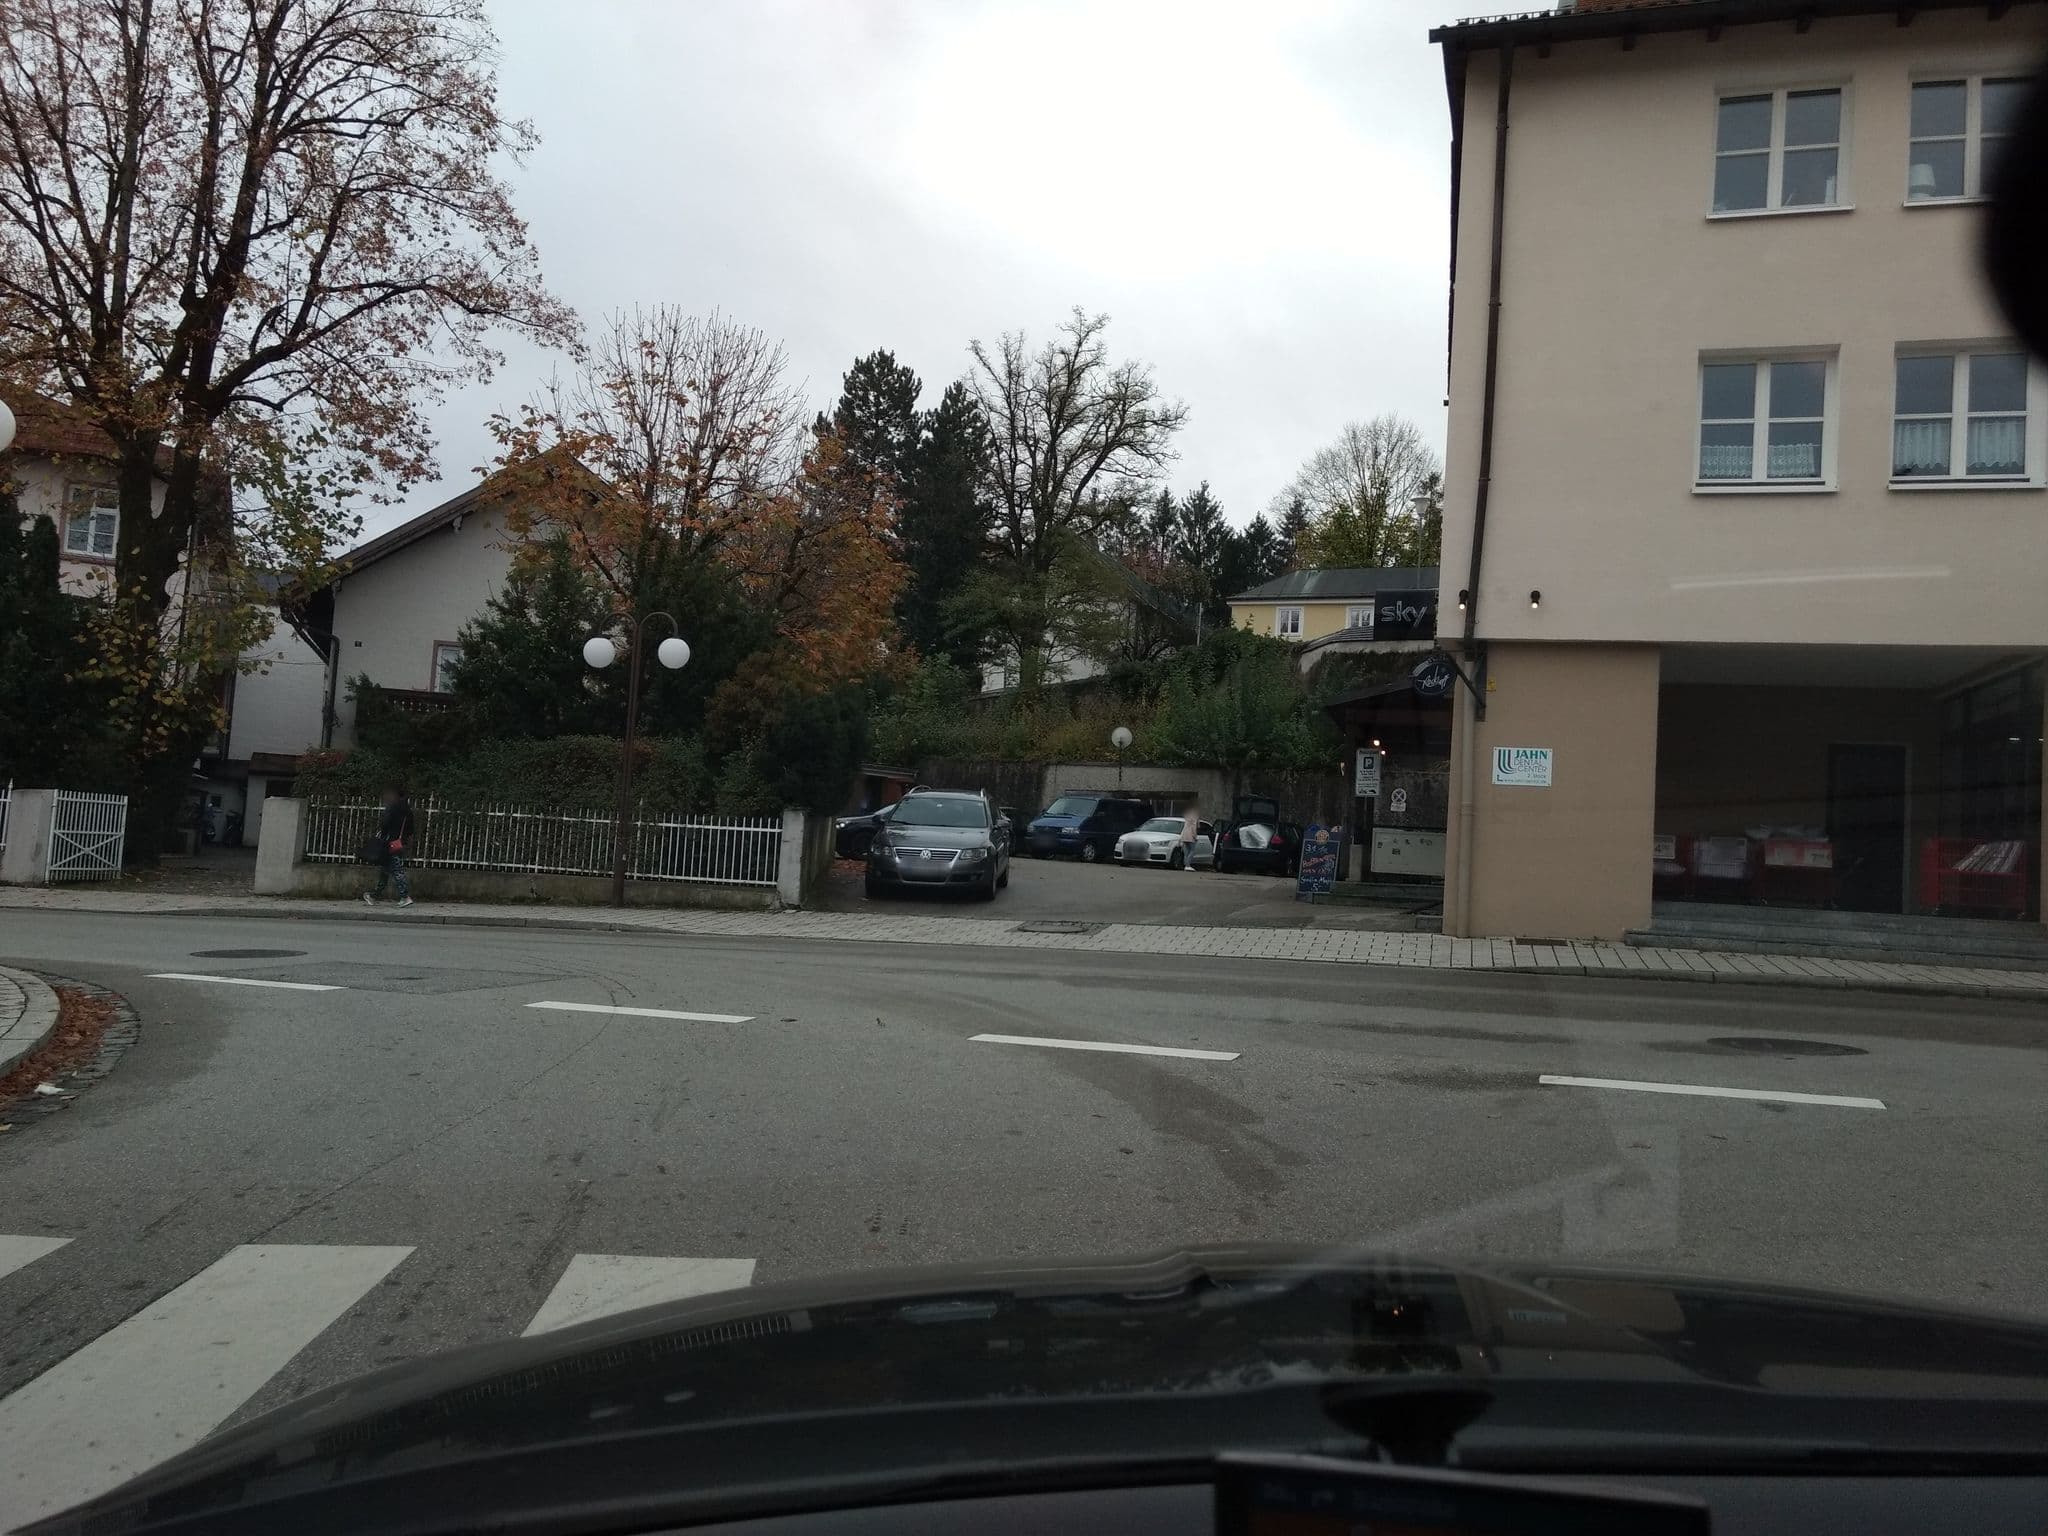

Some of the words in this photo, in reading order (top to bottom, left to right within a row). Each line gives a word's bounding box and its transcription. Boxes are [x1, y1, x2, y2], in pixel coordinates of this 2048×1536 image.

[1381, 600, 1428, 630] sky
[1514, 749, 1548, 760] JAHN
[1517, 765, 1547, 773] CENTER
